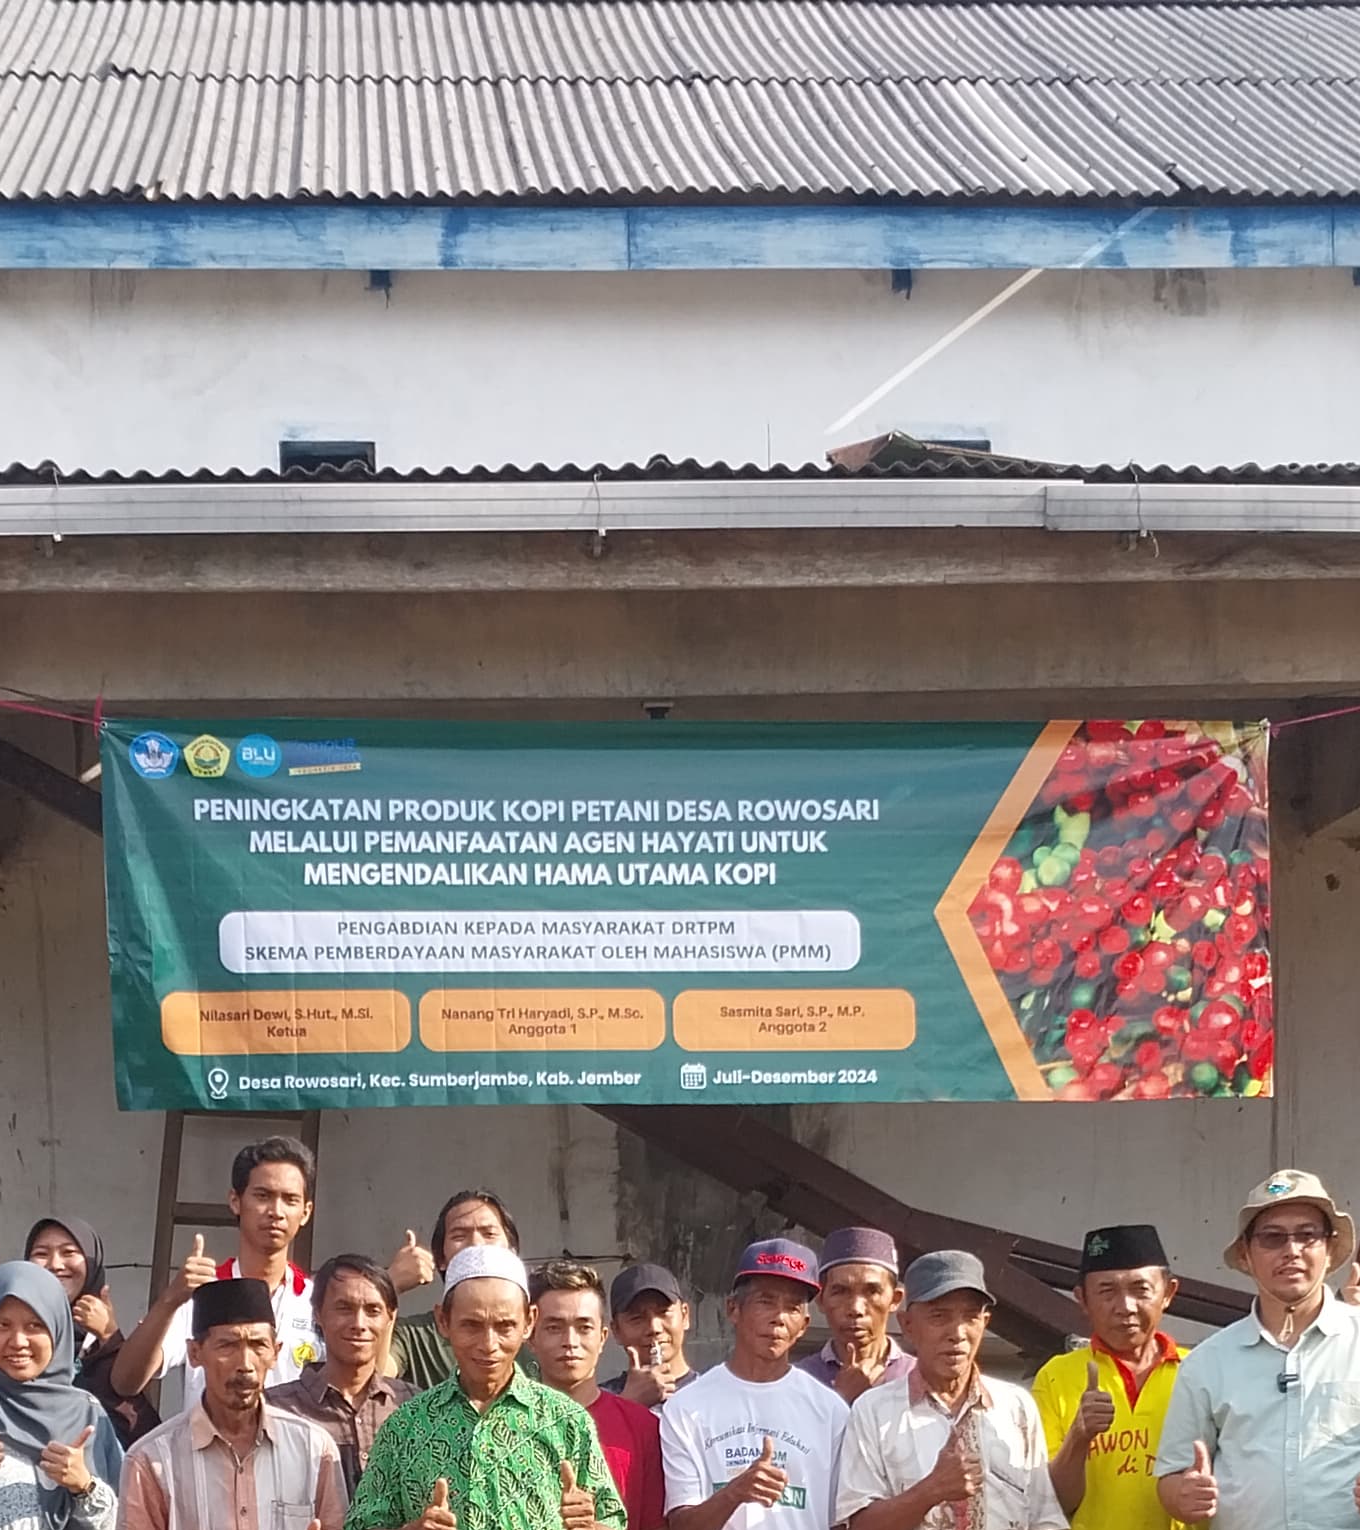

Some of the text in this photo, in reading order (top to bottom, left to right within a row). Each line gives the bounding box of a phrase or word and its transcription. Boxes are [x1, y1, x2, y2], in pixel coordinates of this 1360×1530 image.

[242, 746, 276, 761] BLU
[193, 798, 880, 823] PENINGKATAN PRODUK KOPI PETANI DESA ROWOSARI
[249, 830, 829, 854] MELALUI PEMANFAATAN AGEN HAYATI UNTUK
[303, 862, 777, 886] MENGENDALIKAN HAMA UTAMA KOPI
[337, 920, 735, 936] PENGABDIAN KEPADA MASYARAKAT DRTPM
[244, 944, 832, 962] SKEMA PEMBERDAYAAN MASYARAKAT OLEH MAHASISWA (PMM)
[441, 1008, 494, 1022] Nanang
[496, 1007, 516, 1020] Tri
[720, 1005, 773, 1018] Sasmita
[266, 1025, 307, 1038] Ketua
[508, 1023, 578, 1038] Anggota 1
[758, 1021, 828, 1036] Anggota 2
[239, 1070, 642, 1090] Desa Rowosari, Kec. Sumberjambe, Kab. Jember
[712, 1069, 878, 1085] Juli-Desember 2024
[1087, 1427, 1149, 1461] AWON
[725, 1446, 763, 1459] BADAN
[1117, 1454, 1139, 1475] di
